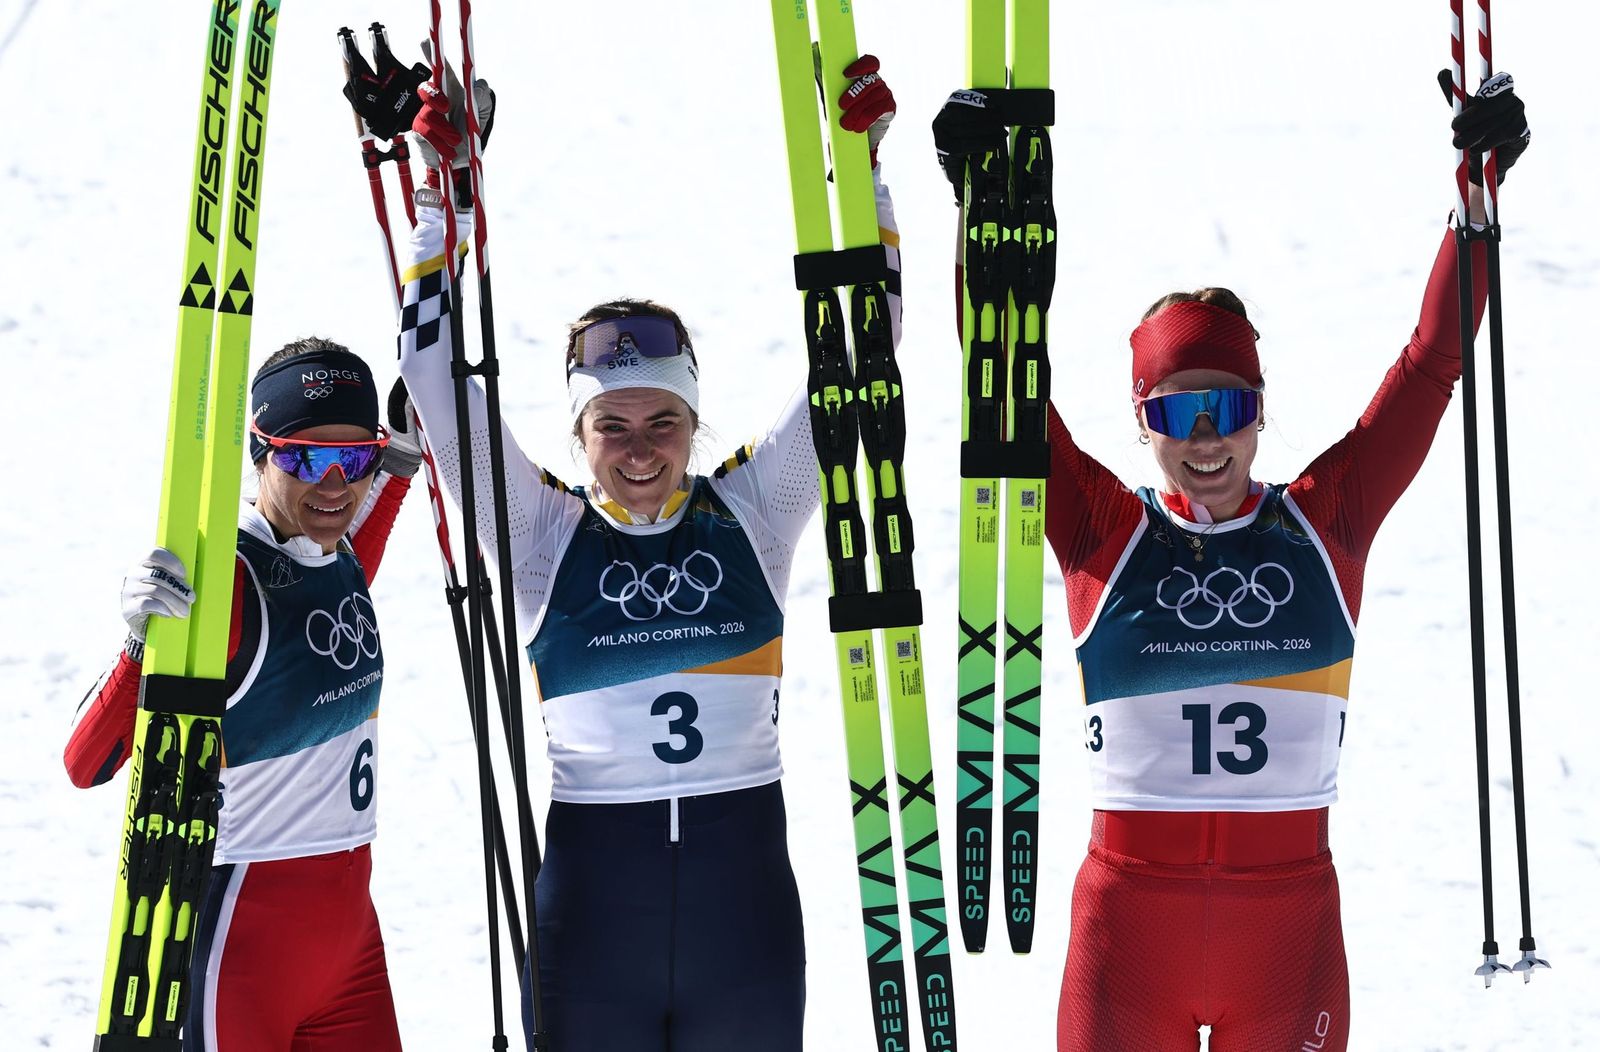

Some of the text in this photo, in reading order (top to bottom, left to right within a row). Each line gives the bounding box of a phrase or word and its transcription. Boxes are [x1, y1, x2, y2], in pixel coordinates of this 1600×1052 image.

[196, 0, 238, 245] FISCHER
[234, 0, 277, 251] FISCHER
[302, 369, 361, 384] NORGE
[608, 358, 639, 370] SWE
[587, 621, 745, 648] MILANO CORTINA 2026
[1140, 638, 1311, 653] MILANO CORTINA 2026
[312, 681, 356, 707] MILANO
[356, 669, 382, 690] CORTINA
[650, 691, 704, 764] 3
[1182, 701, 1269, 775] 13
[350, 738, 373, 811] 6
[965, 827, 985, 920] SPEED
[1012, 830, 1031, 923] SPEED
[927, 974, 951, 1052] PEED
